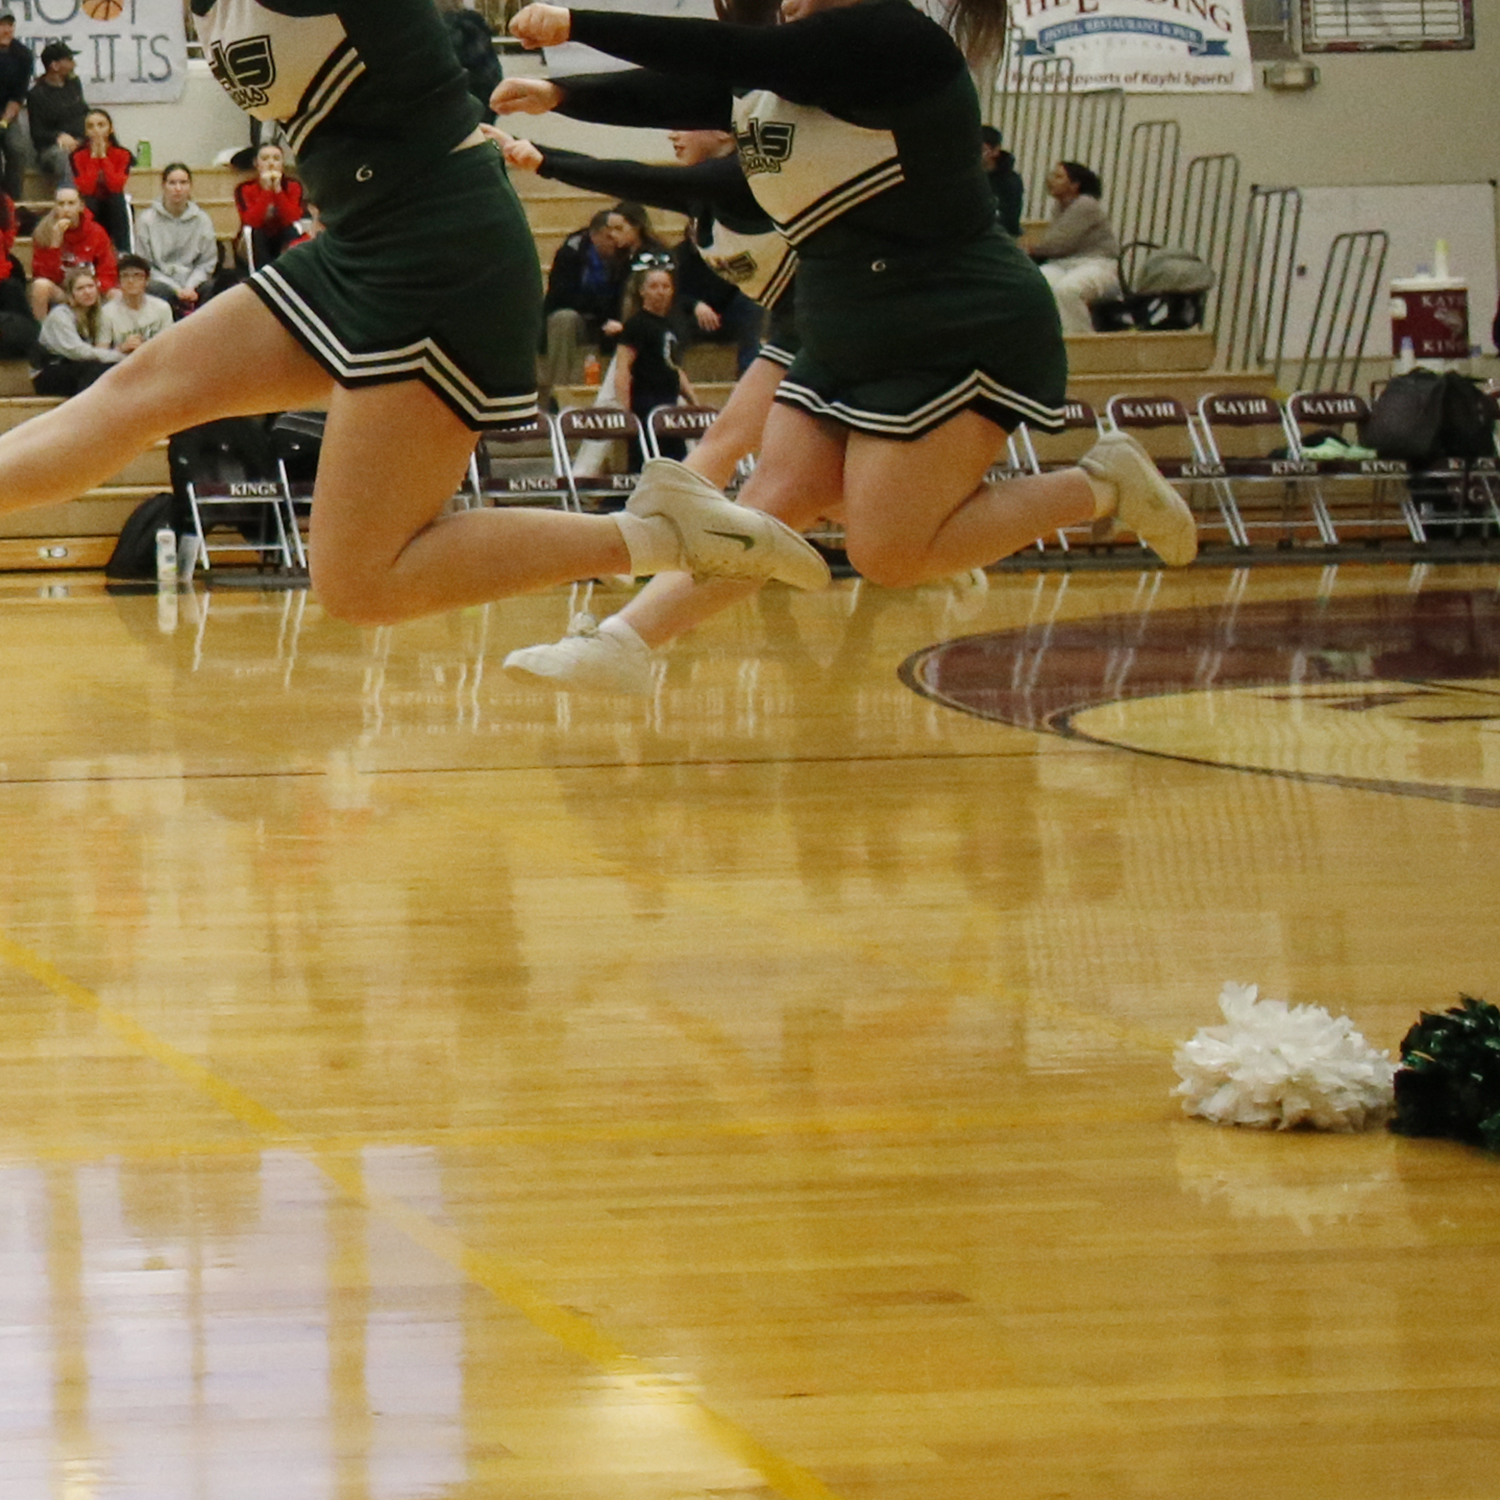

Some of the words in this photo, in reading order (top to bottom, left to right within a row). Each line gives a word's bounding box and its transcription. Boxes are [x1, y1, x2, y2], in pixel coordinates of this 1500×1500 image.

[88, 33, 121, 84] IT
[130, 34, 173, 83] IS
[1121, 402, 1176, 418] KAYHI
[1213, 399, 1268, 415] KAYHI
[1303, 398, 1357, 414] KAYHI
[571, 413, 627, 429] KAYHI
[1361, 460, 1407, 473] KINGS
[230, 482, 278, 496] KINGS
[509, 477, 558, 491] KINGS
